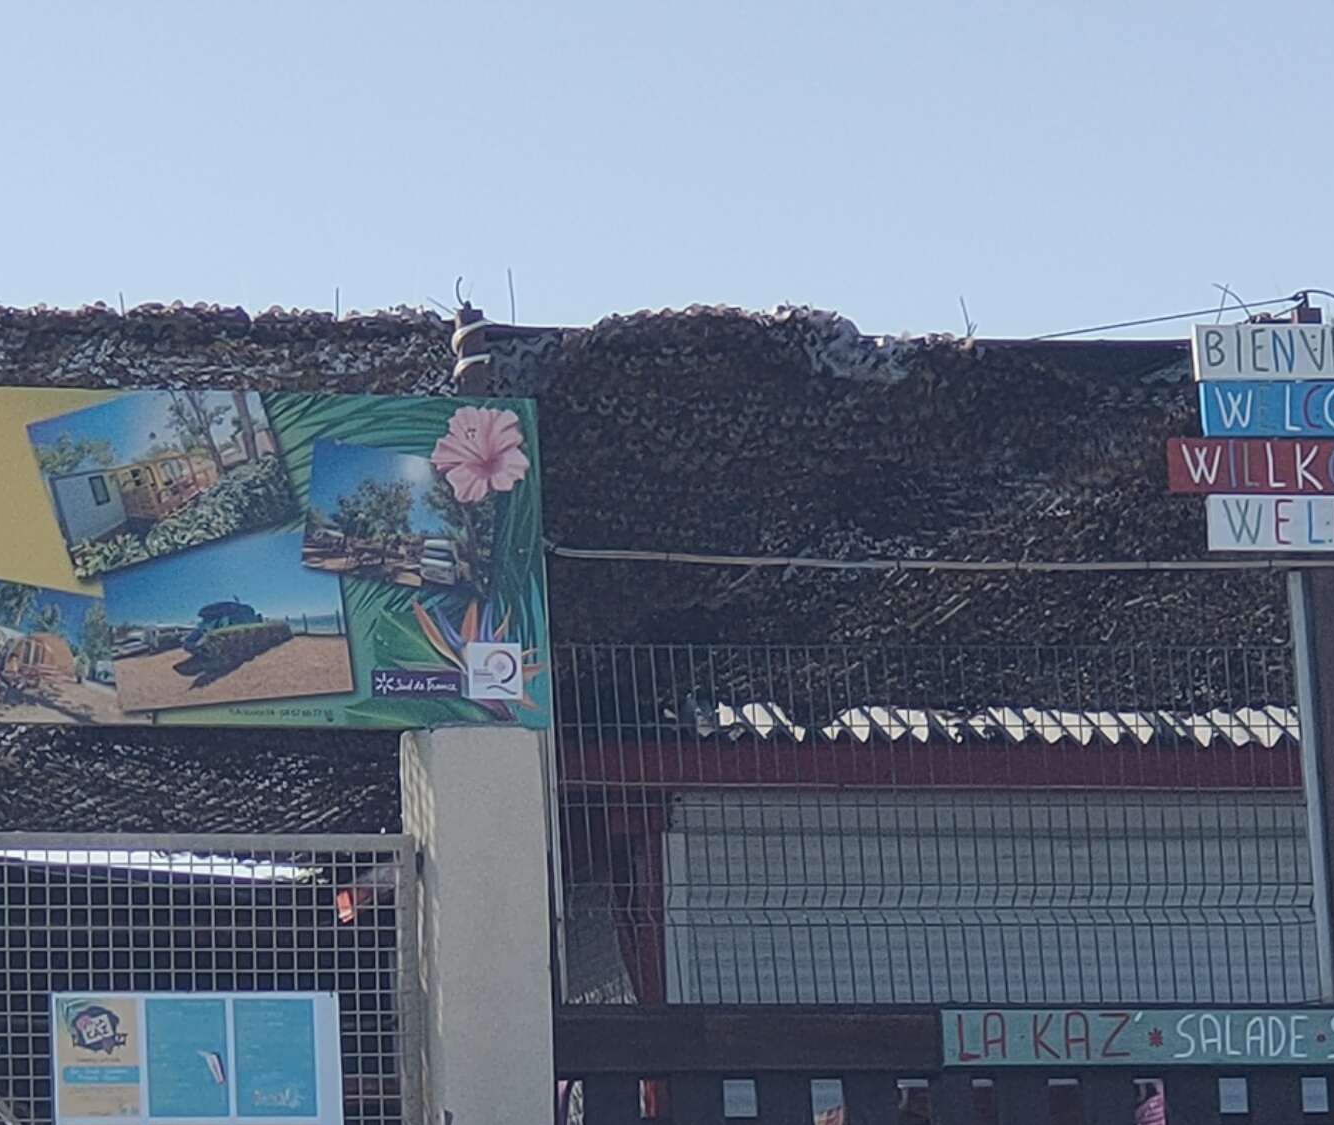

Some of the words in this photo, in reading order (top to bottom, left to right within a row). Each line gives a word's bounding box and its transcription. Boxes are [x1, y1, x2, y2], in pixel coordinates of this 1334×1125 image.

[394, 678, 414, 692] Sud
[426, 677, 458, 692] France
[957, 1011, 1008, 1063] LA
[1173, 1013, 1311, 1059] SALADE
